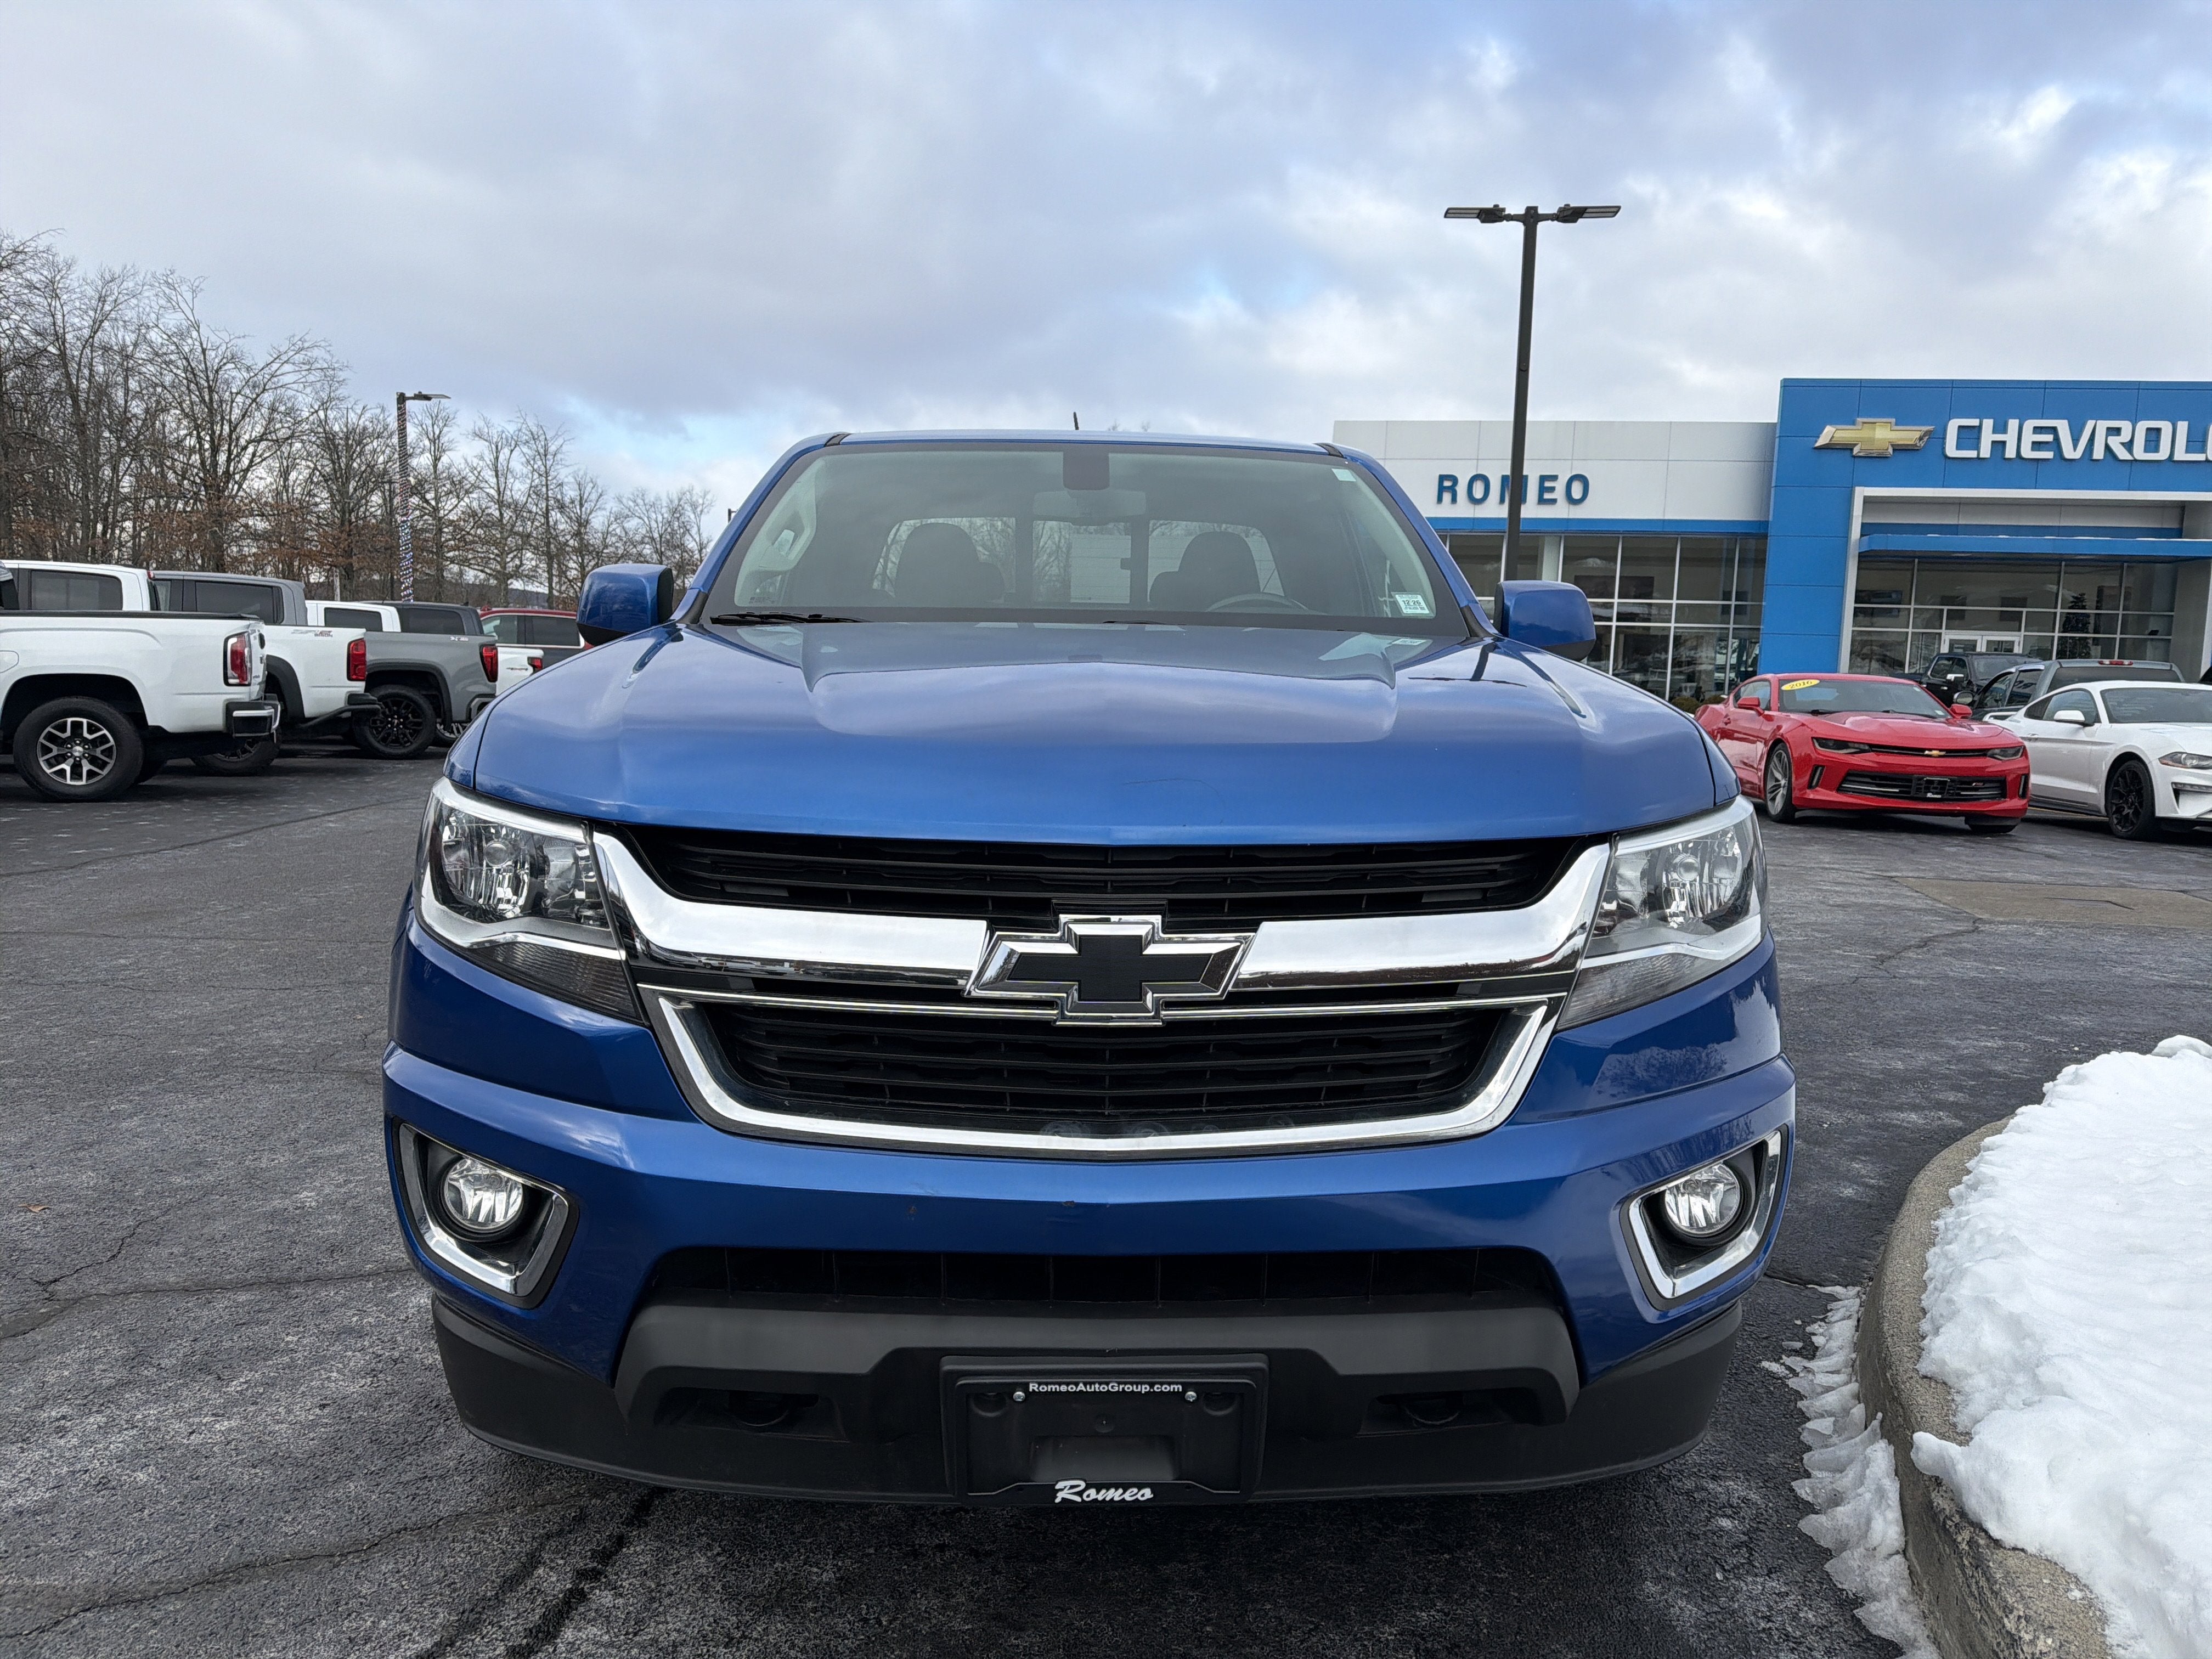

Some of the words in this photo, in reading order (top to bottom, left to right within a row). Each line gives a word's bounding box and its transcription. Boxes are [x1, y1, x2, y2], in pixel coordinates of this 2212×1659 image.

[1945, 418, 2212, 461] CHEVROL
[1436, 473, 1590, 505] ROMEO
[1029, 1382, 1183, 1394] RomeoAutoGroup.com
[1054, 1480, 1154, 1503] Romeo
